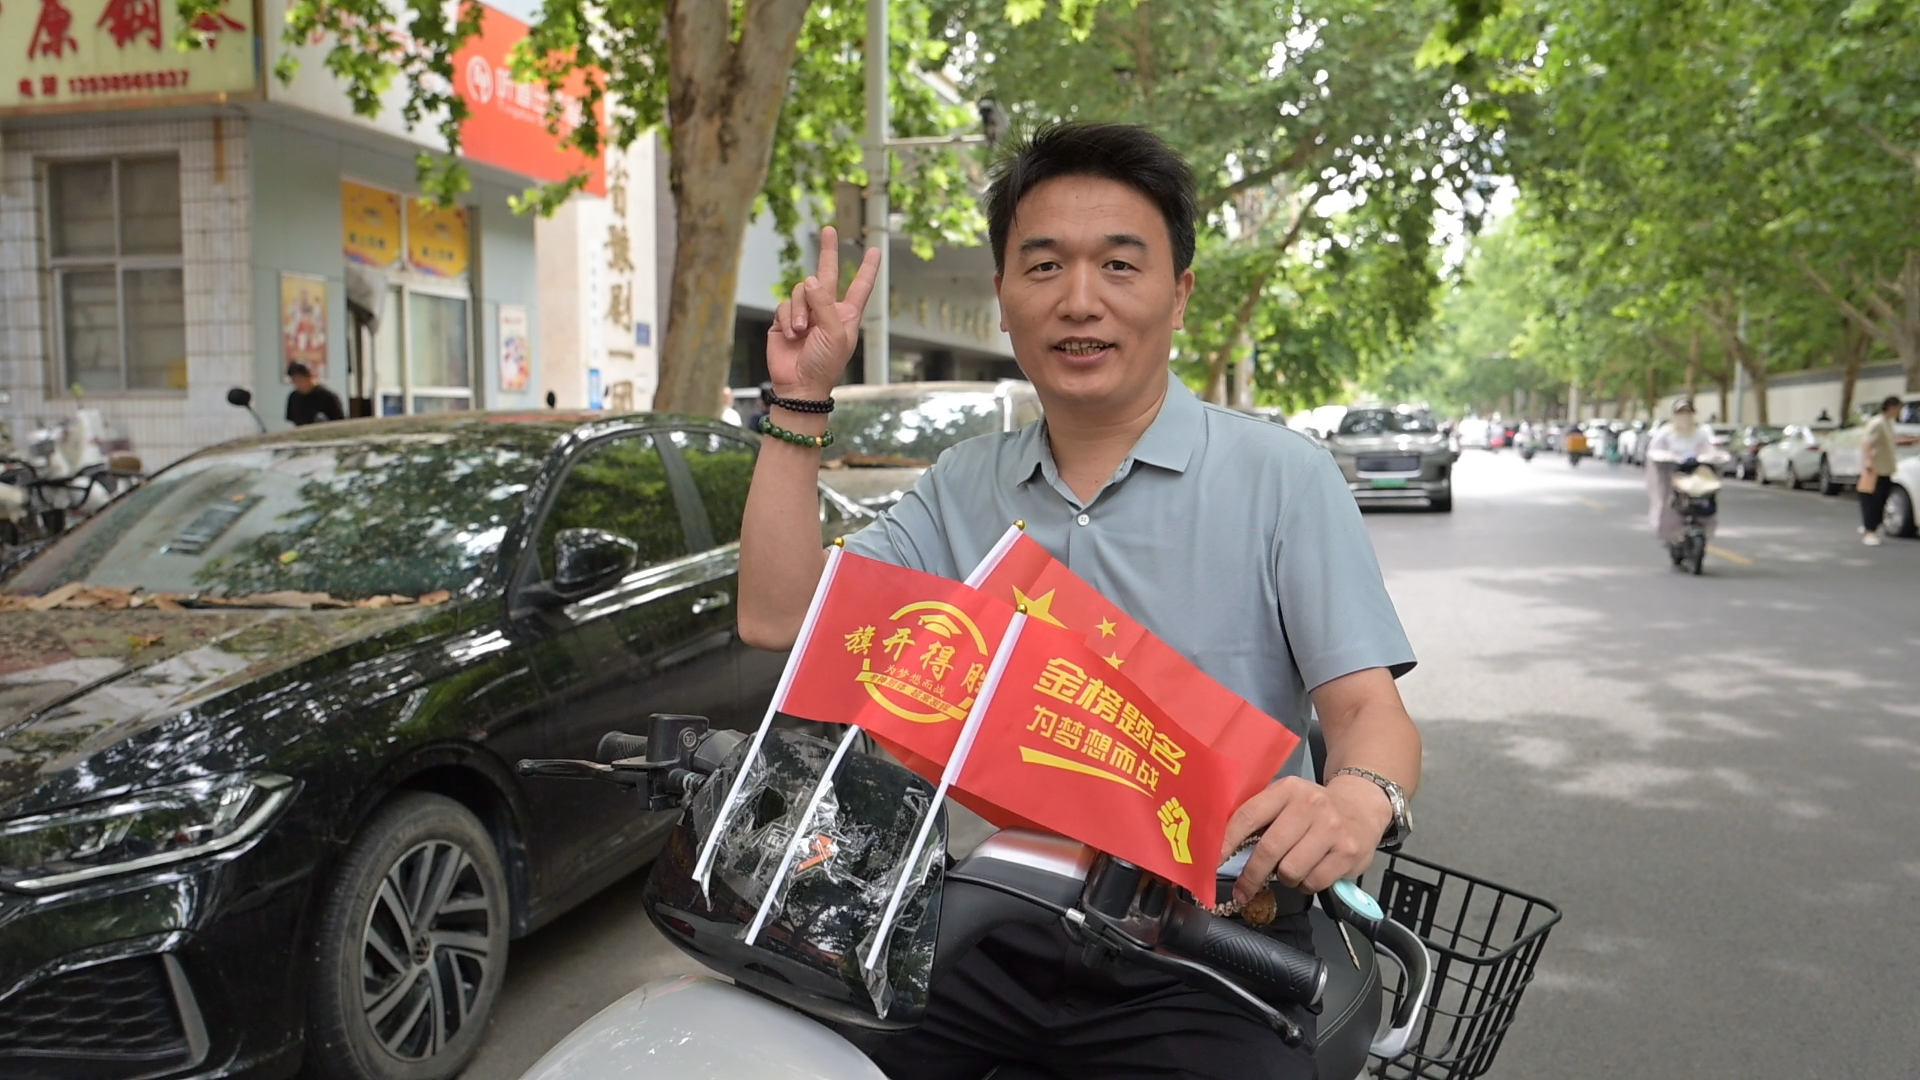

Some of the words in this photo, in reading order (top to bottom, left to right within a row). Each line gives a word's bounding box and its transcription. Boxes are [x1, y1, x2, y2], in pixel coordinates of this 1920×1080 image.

[884, 664, 946, 698] 为梦想而战
[1032, 657, 1187, 776] 金榜题名
[1026, 704, 1160, 792] 为梦想而战
